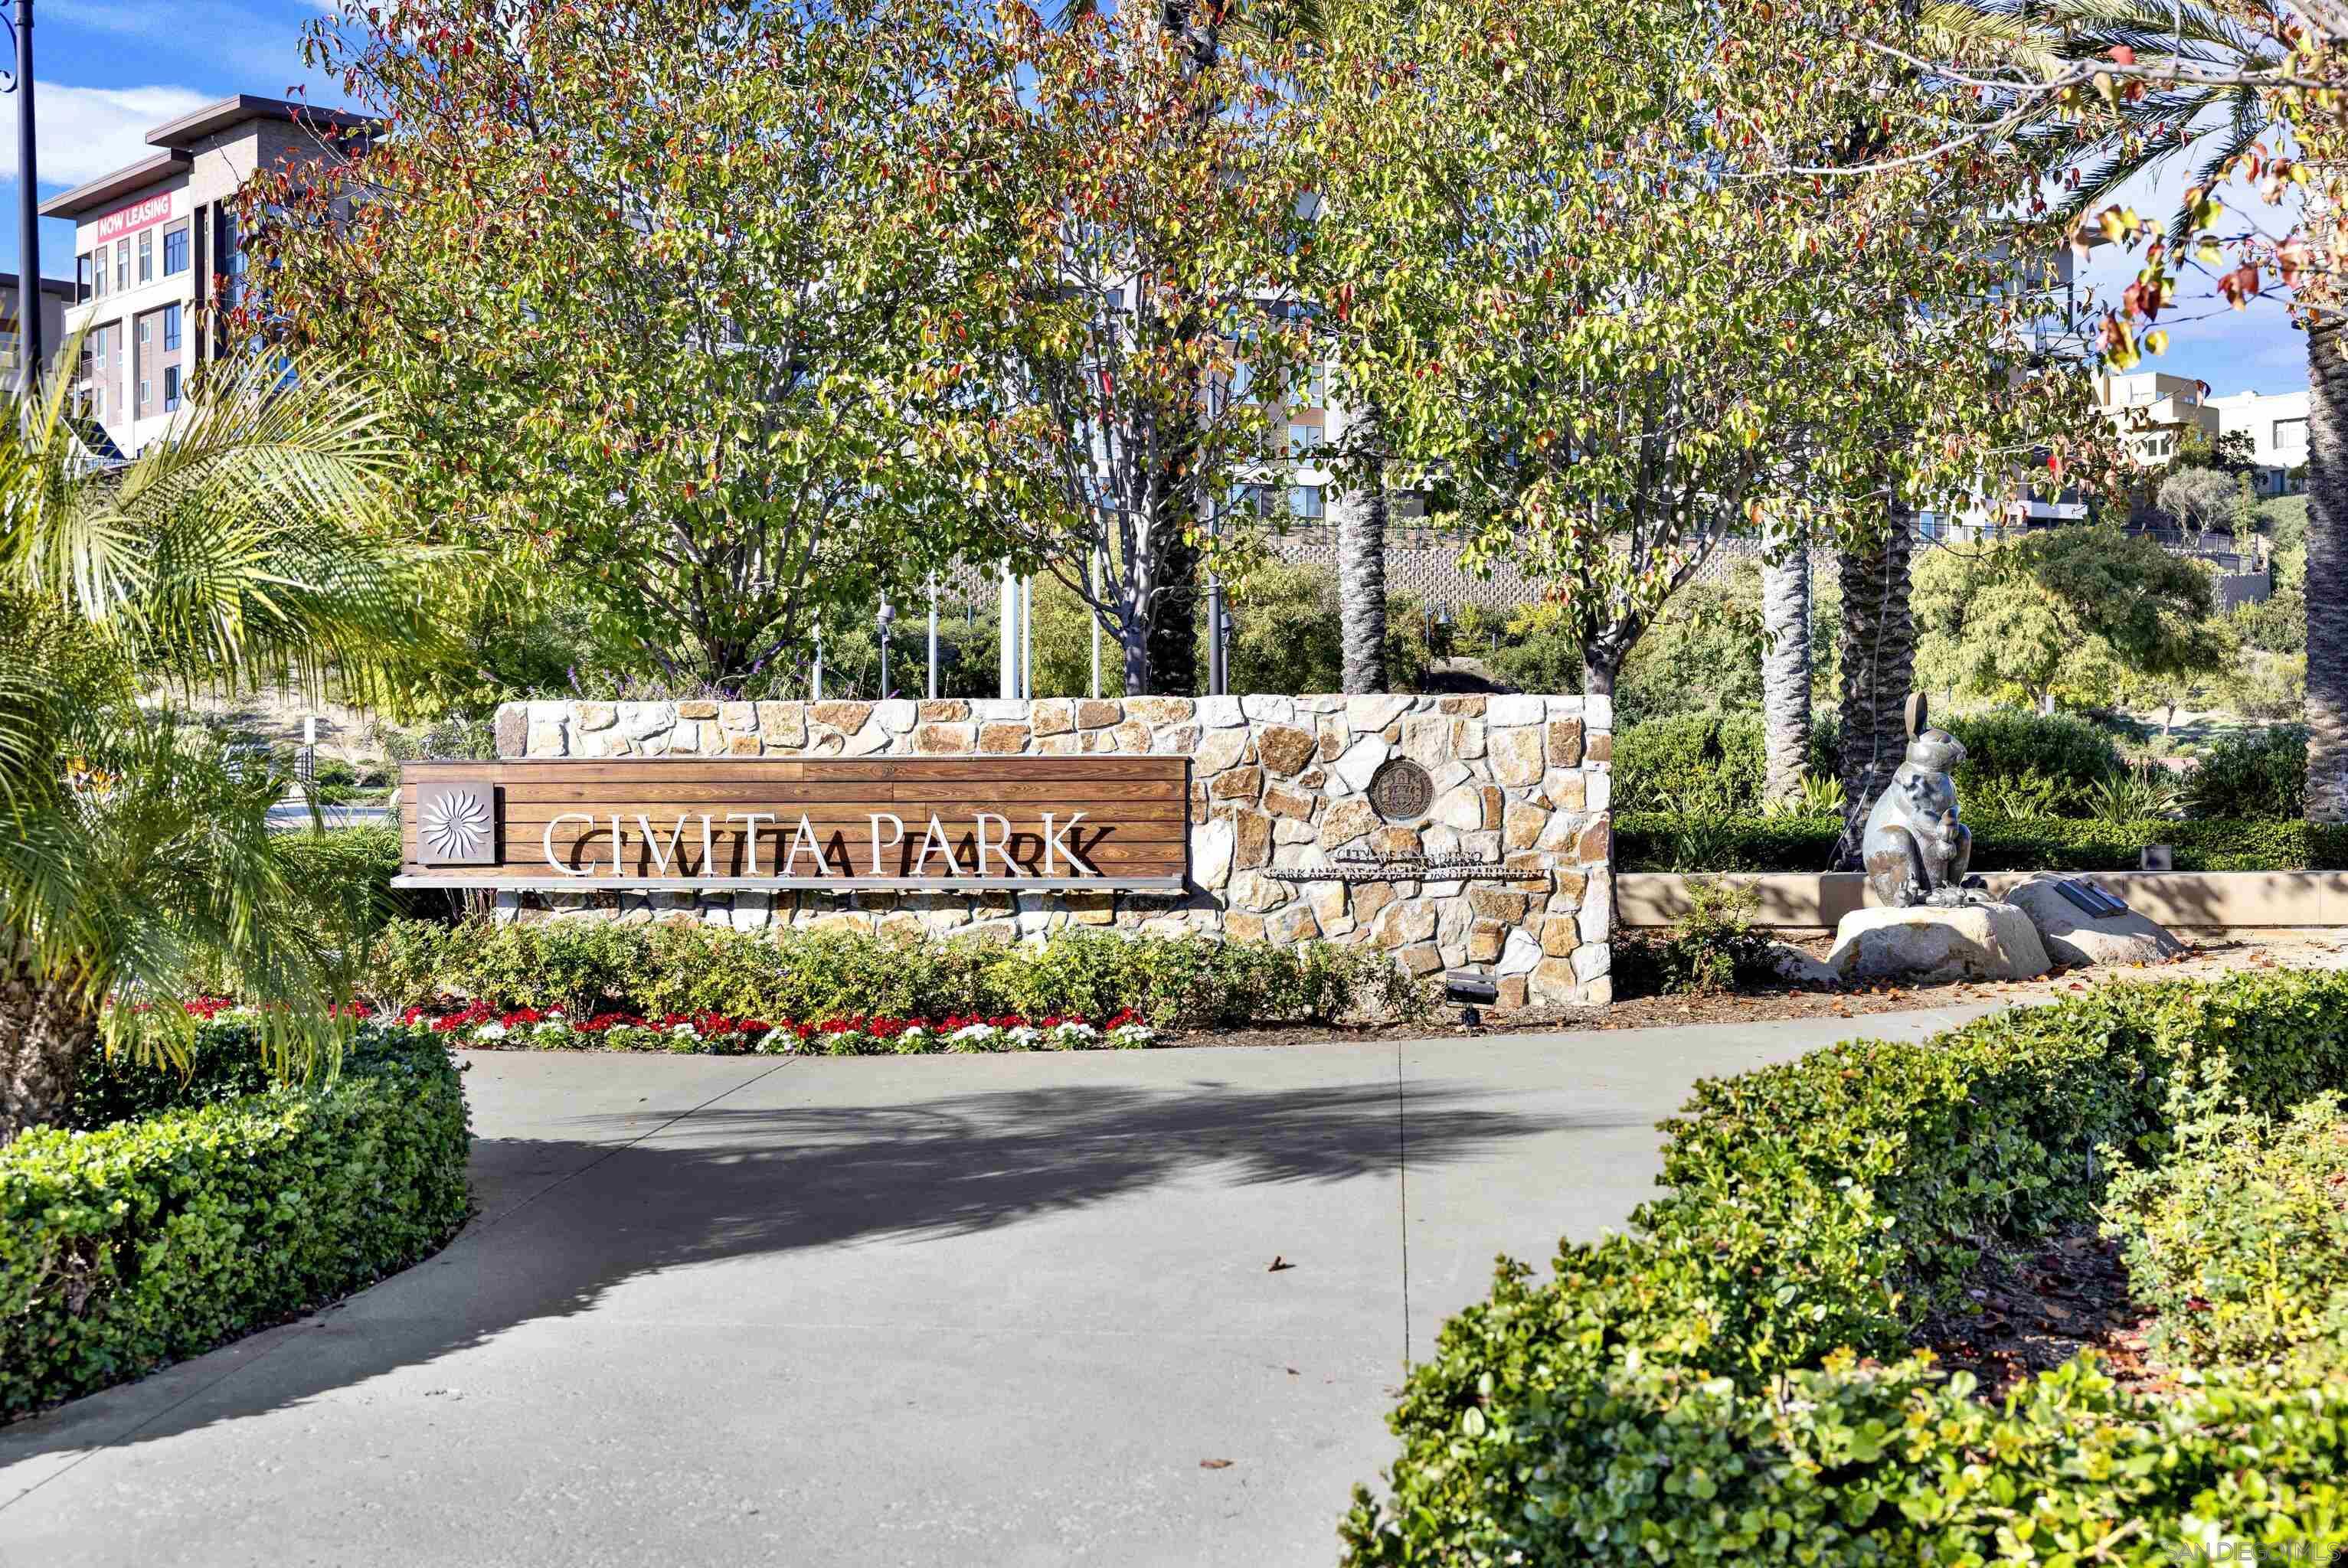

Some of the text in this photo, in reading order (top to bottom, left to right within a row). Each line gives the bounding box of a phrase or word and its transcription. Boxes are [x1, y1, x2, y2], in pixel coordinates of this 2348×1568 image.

[100, 194, 168, 237] NOW LEASING
[544, 812, 1099, 875] CIVITA PARK
